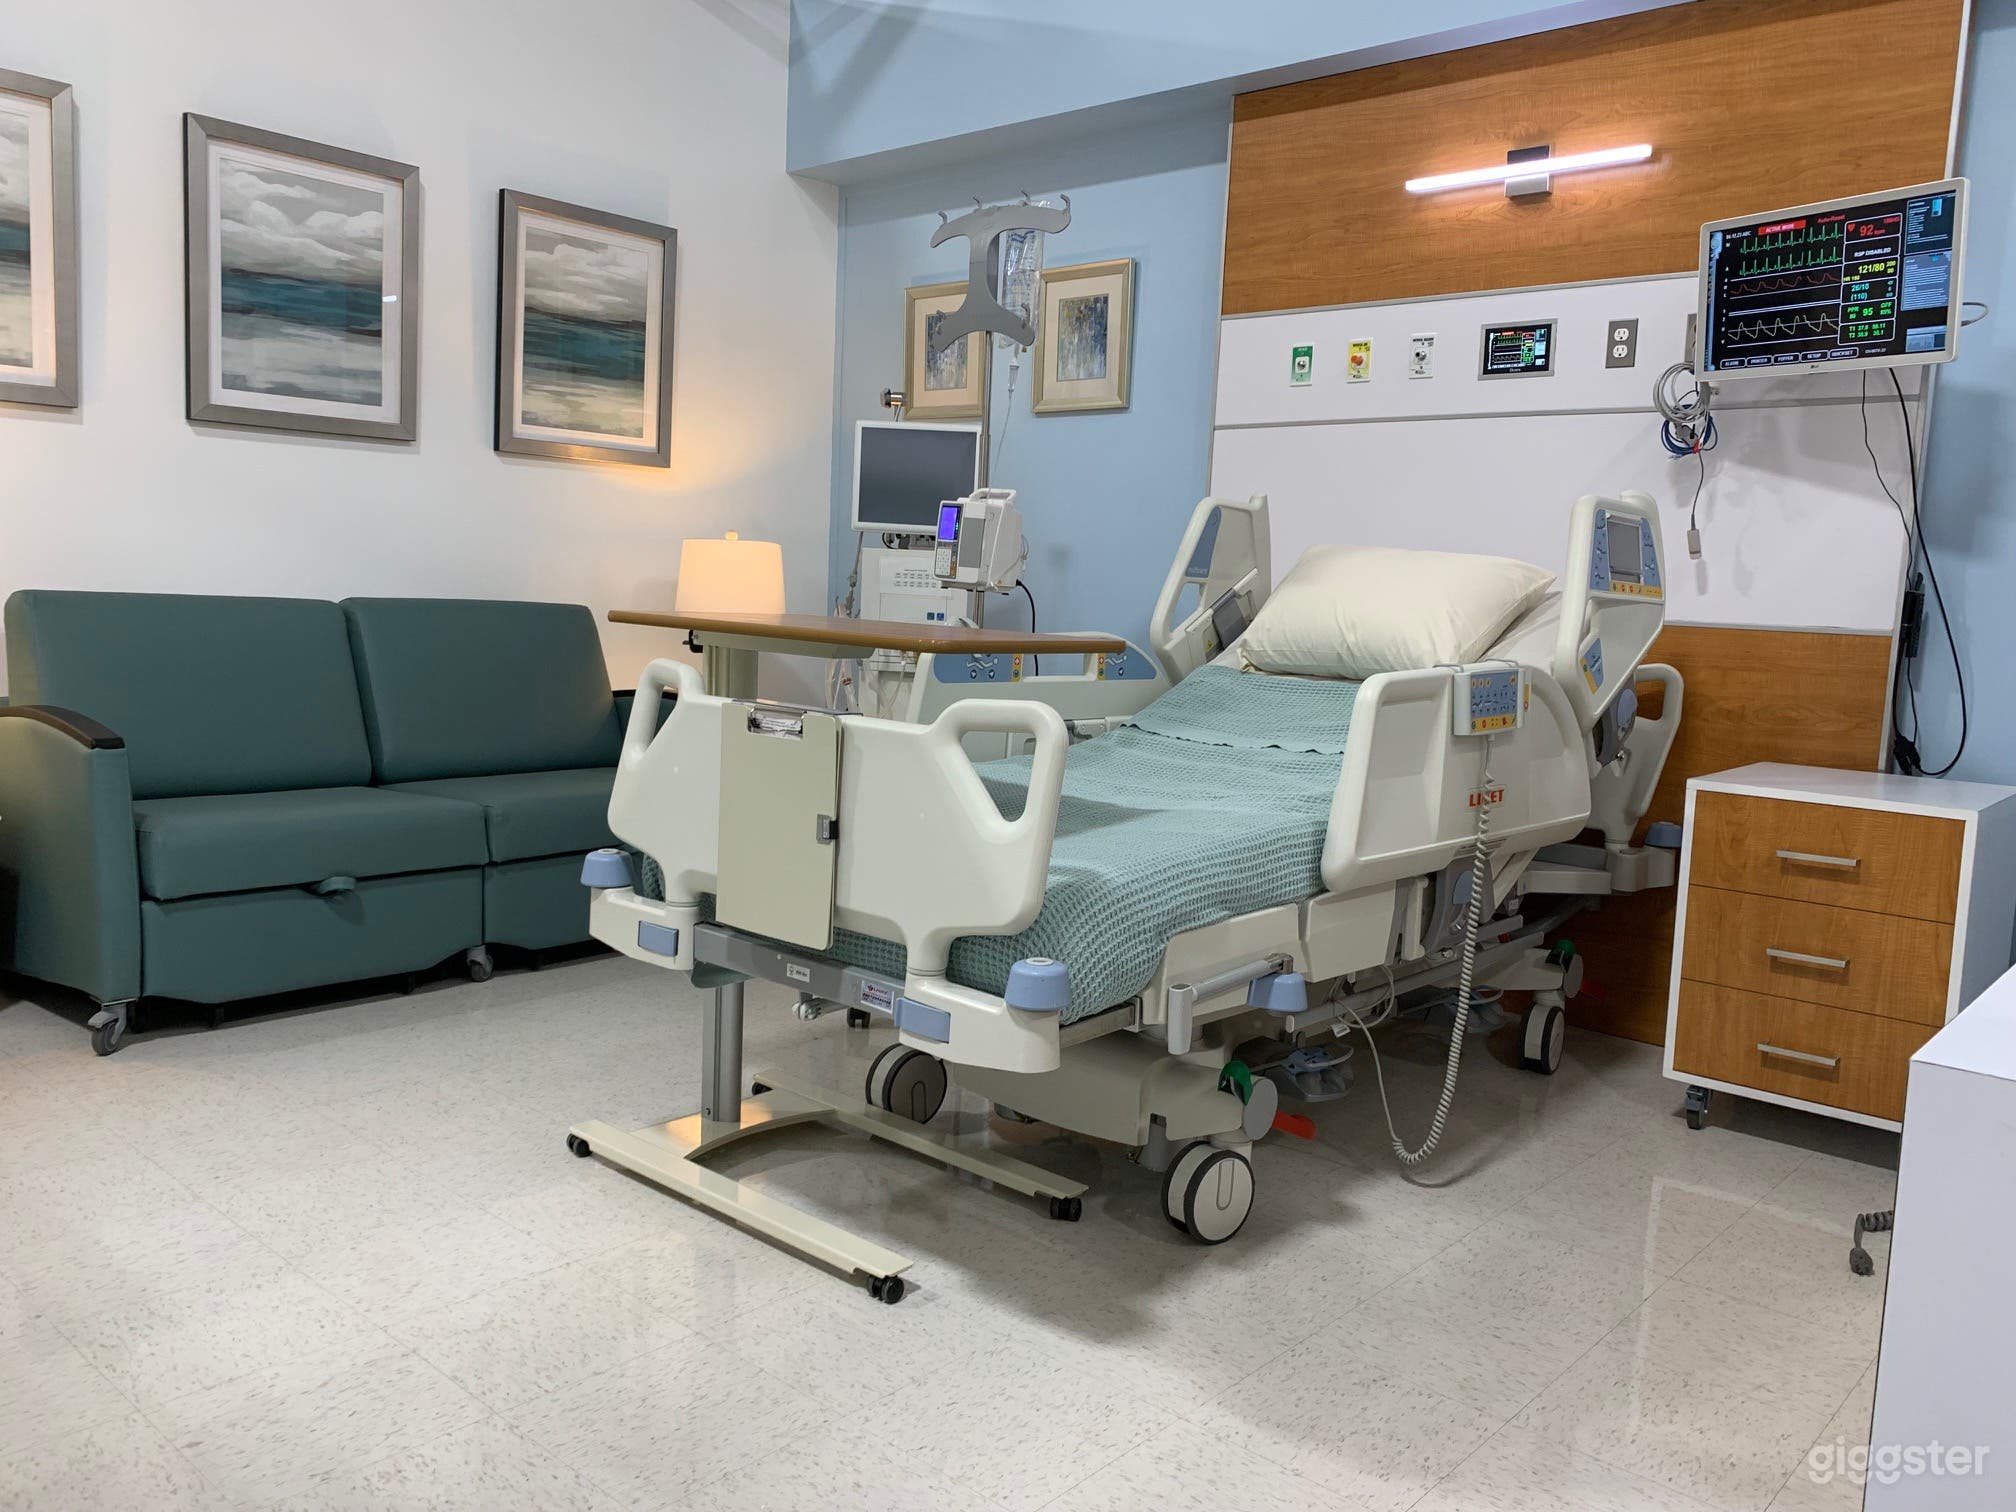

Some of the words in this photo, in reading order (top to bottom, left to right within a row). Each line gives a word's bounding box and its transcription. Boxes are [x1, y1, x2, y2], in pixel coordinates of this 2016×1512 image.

[1860, 224, 1874, 236] 92
[1865, 247, 1892, 257] DISABLED
[1858, 262, 1885, 275] 121/80
[1850, 292, 1868, 302] (110)
[1862, 307, 1874, 317] 95
[1469, 789, 1505, 808] LIET
